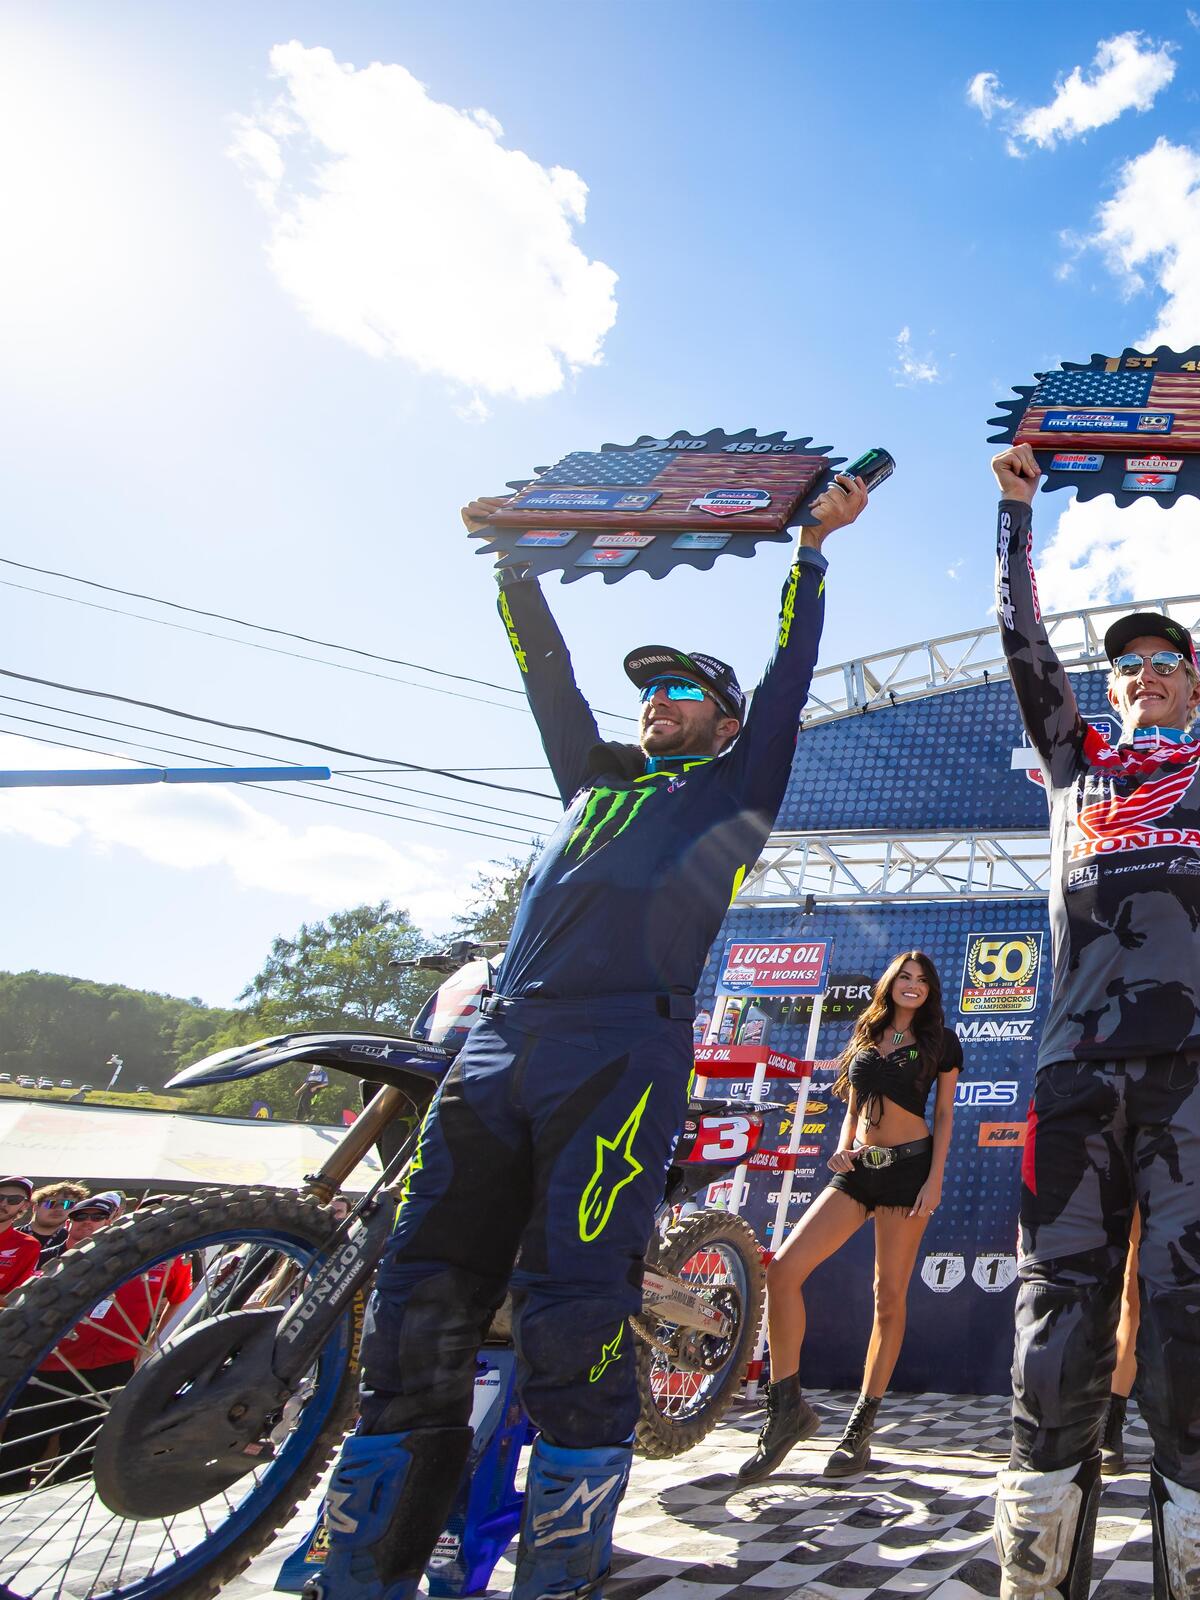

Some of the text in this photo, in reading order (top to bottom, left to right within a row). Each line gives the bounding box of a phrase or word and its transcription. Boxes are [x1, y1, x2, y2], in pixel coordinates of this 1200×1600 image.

[1048, 420, 1128, 428] MOTOCROSS
[1142, 416, 1167, 425] 50
[1130, 460, 1178, 468] EKLUND
[600, 535, 650, 544] EKLUND
[640, 655, 674, 665] YAMAHA
[698, 655, 726, 674] YAMAHA
[1114, 861, 1165, 875] DUNLOP
[733, 946, 821, 964] LUCAS OIL
[974, 941, 1032, 983] 50
[756, 969, 818, 980] IT WORKS!
[983, 988, 1016, 996] LUCAS OIL
[983, 995, 1032, 1004] MOTOCROSS
[781, 1004, 855, 1014] ENERGY
[694, 1049, 731, 1060] CAS OIL
[767, 1054, 797, 1073] LUCAS OIL
[953, 1081, 1019, 1107] WPS
[702, 1116, 750, 1160] 3
[987, 1127, 1020, 1141] KTM
[769, 1156, 779, 1168] OIL
[766, 1191, 812, 1204] STCYC
[935, 1259, 955, 1285] 1ST
[986, 1259, 1007, 1285] 1ST
[284, 1226, 368, 1344] DUNLOP
[328, 1258, 365, 1306] BRAKING
